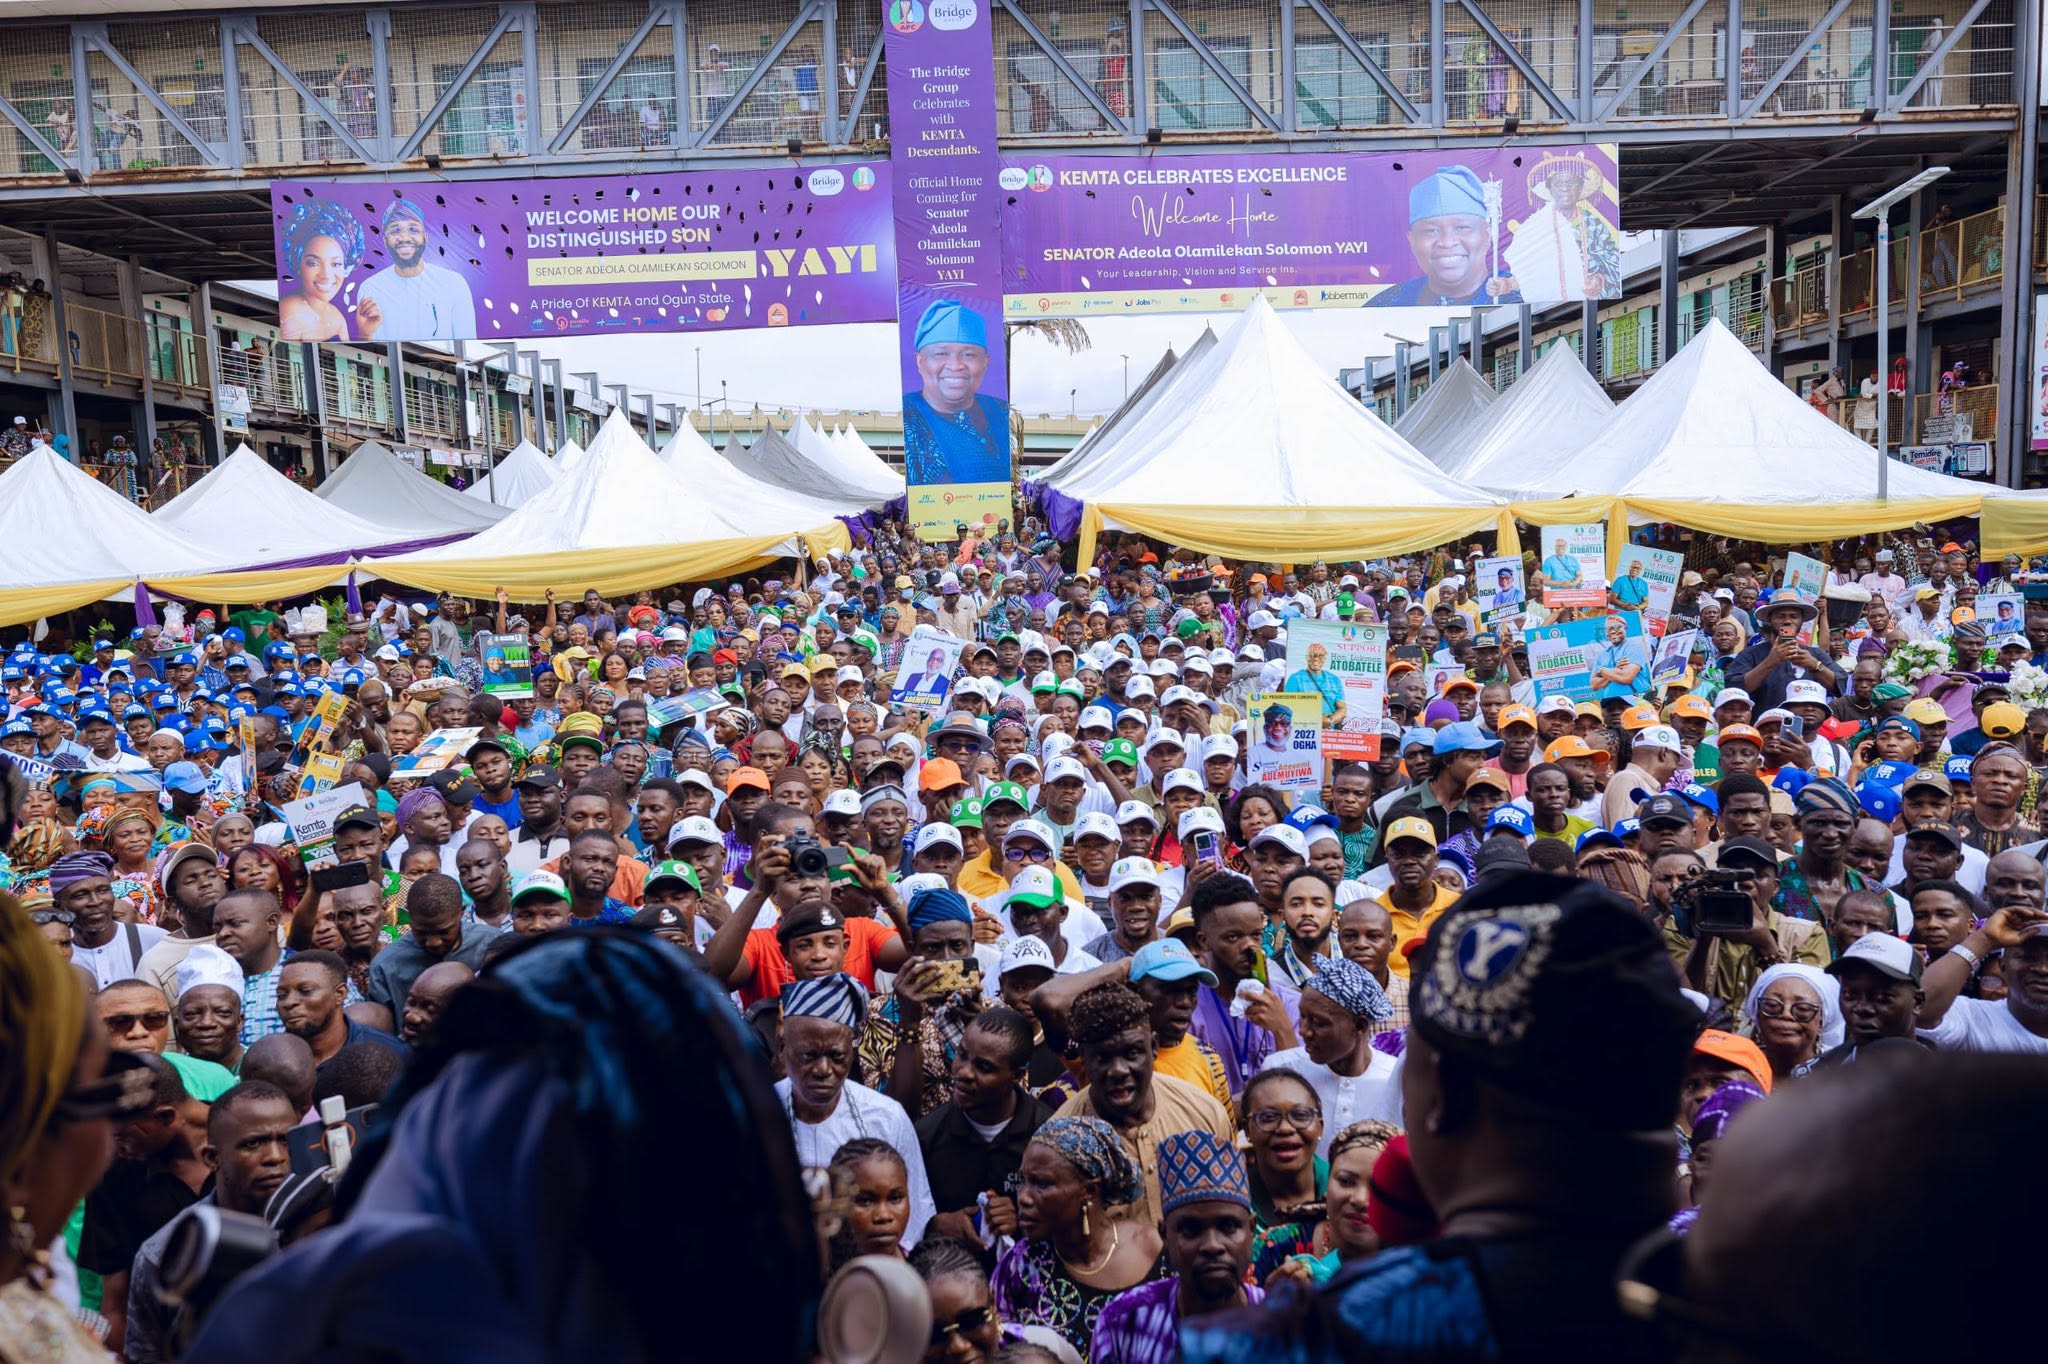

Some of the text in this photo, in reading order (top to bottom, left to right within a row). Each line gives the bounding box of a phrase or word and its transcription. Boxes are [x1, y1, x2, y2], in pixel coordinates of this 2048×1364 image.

[934, 7, 972, 20] Bridge
[909, 65, 971, 79] The Bridge
[923, 83, 959, 95] Group
[913, 98, 970, 110] Celebrates
[930, 113, 955, 124] with
[922, 129, 965, 141] KEMTA
[907, 144, 981, 158] Descendants.
[812, 176, 841, 187] Bridge
[909, 176, 983, 189] Official Home
[1001, 175, 1025, 184] Bridge
[1060, 166, 1348, 186] KEMTA CELEBRATES EXCELLENCE
[916, 191, 977, 204] Coming for
[526, 205, 721, 226] WELCOME HOME OUR
[926, 208, 970, 219] Senator
[1131, 191, 1280, 238] Welcome Home
[930, 222, 967, 234] Adeola
[527, 227, 711, 249] DISTINGUISHED SON
[917, 238, 981, 251] Olamilekan
[1043, 241, 1368, 262] SENATOR Adeola Olamilekan Solomon YAYI
[764, 244, 877, 278] YAYI
[926, 254, 975, 266] Solomon
[535, 260, 747, 277] SENATOR ADEOLA OLAMILEKAN SOLOMON
[936, 269, 965, 281] YAYI
[1096, 269, 1120, 278] Your
[1184, 266, 1215, 276] Vision
[1218, 266, 1236, 275] and
[1239, 265, 1277, 275] Service
[530, 292, 734, 310] A Pride Of KEMTA and Ogun State.
[1569, 546, 1603, 554] ATOBATELE
[1642, 571, 1676, 584] ATOBATELE
[1330, 660, 1382, 673] ATOBATELE
[1537, 654, 1585, 670] ATOBATELE
[1342, 717, 1380, 733] 2027
[1294, 729, 1316, 739] 2027
[1293, 740, 1317, 750] OGHA
[1262, 767, 1313, 782] ADEMUYIWA
[294, 819, 327, 836] Kemta
[1494, 817, 1523, 827] YAYI
[298, 827, 334, 842] Descendan
[304, 843, 336, 859] YAY
[1012, 948, 1047, 960] YAYI
